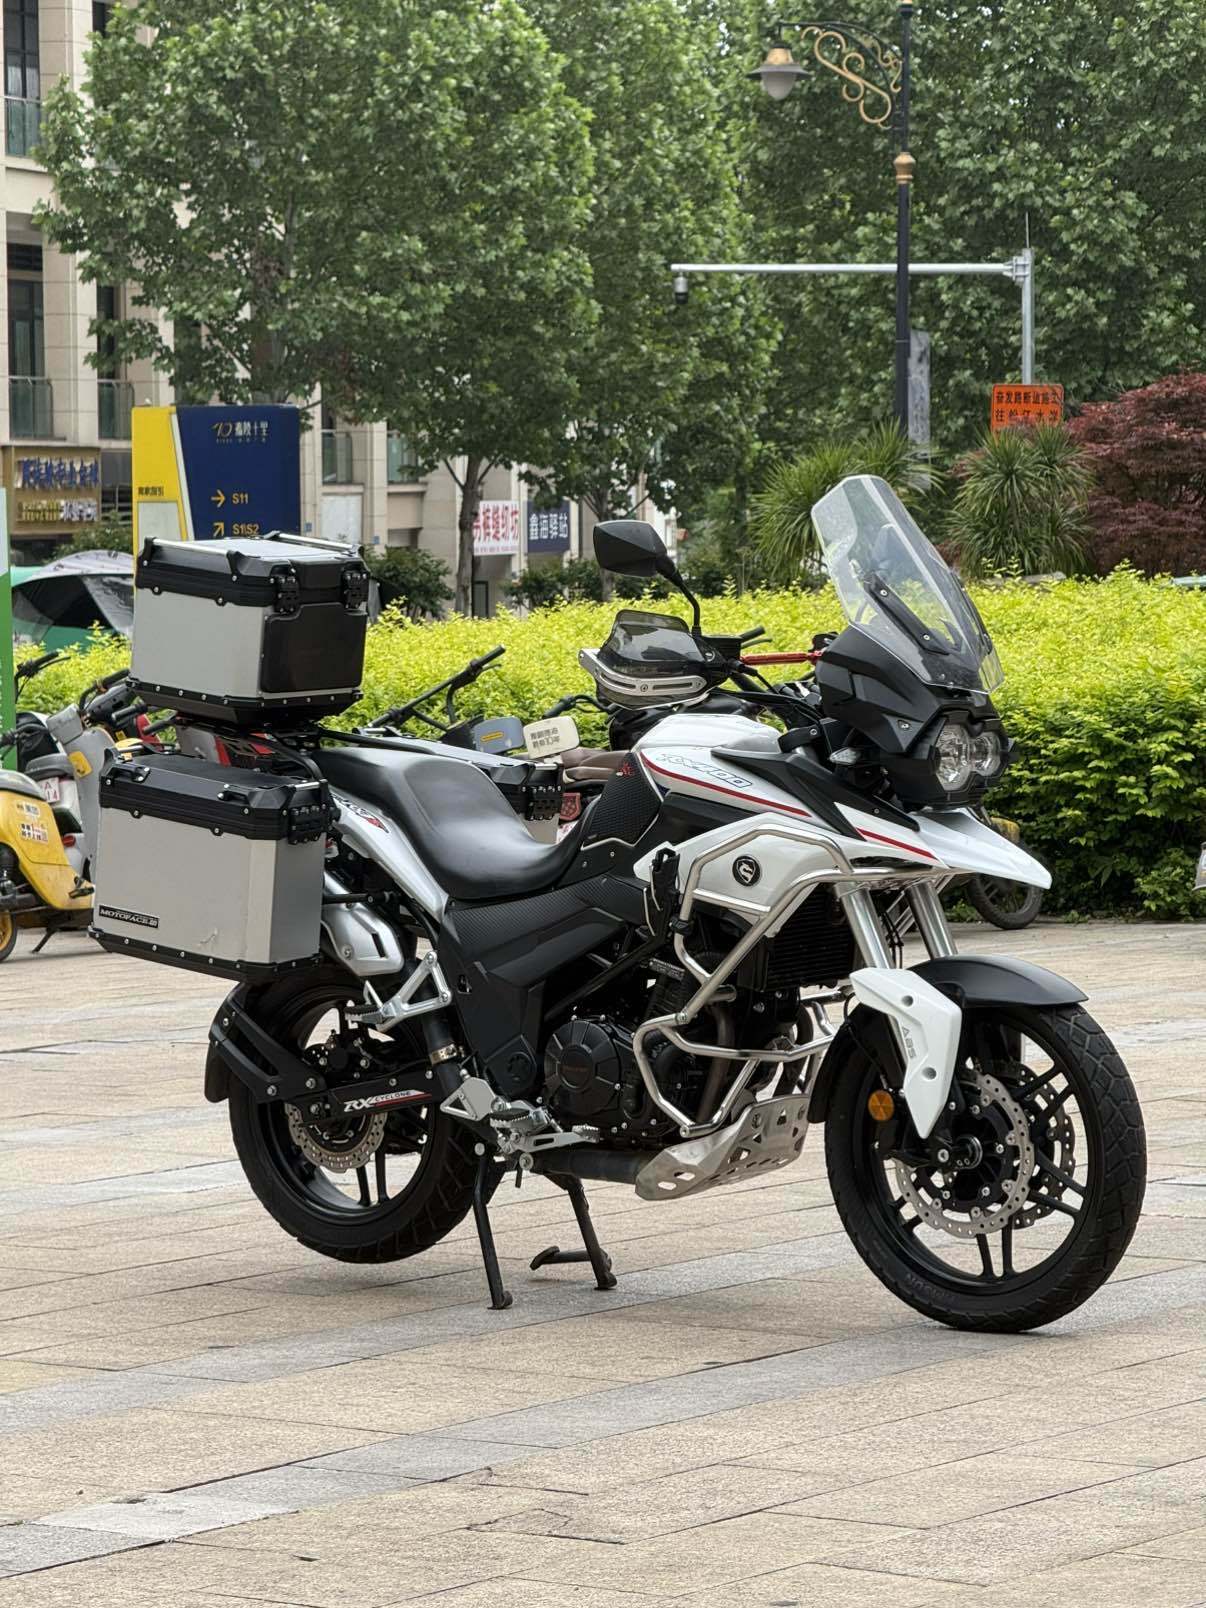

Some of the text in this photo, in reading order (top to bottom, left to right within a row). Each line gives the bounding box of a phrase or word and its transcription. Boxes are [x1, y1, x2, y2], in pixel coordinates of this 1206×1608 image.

[232, 493, 249, 504] S11
[902, 1026, 917, 1059] ABS
[375, 1091, 411, 1101] CYCLONE
